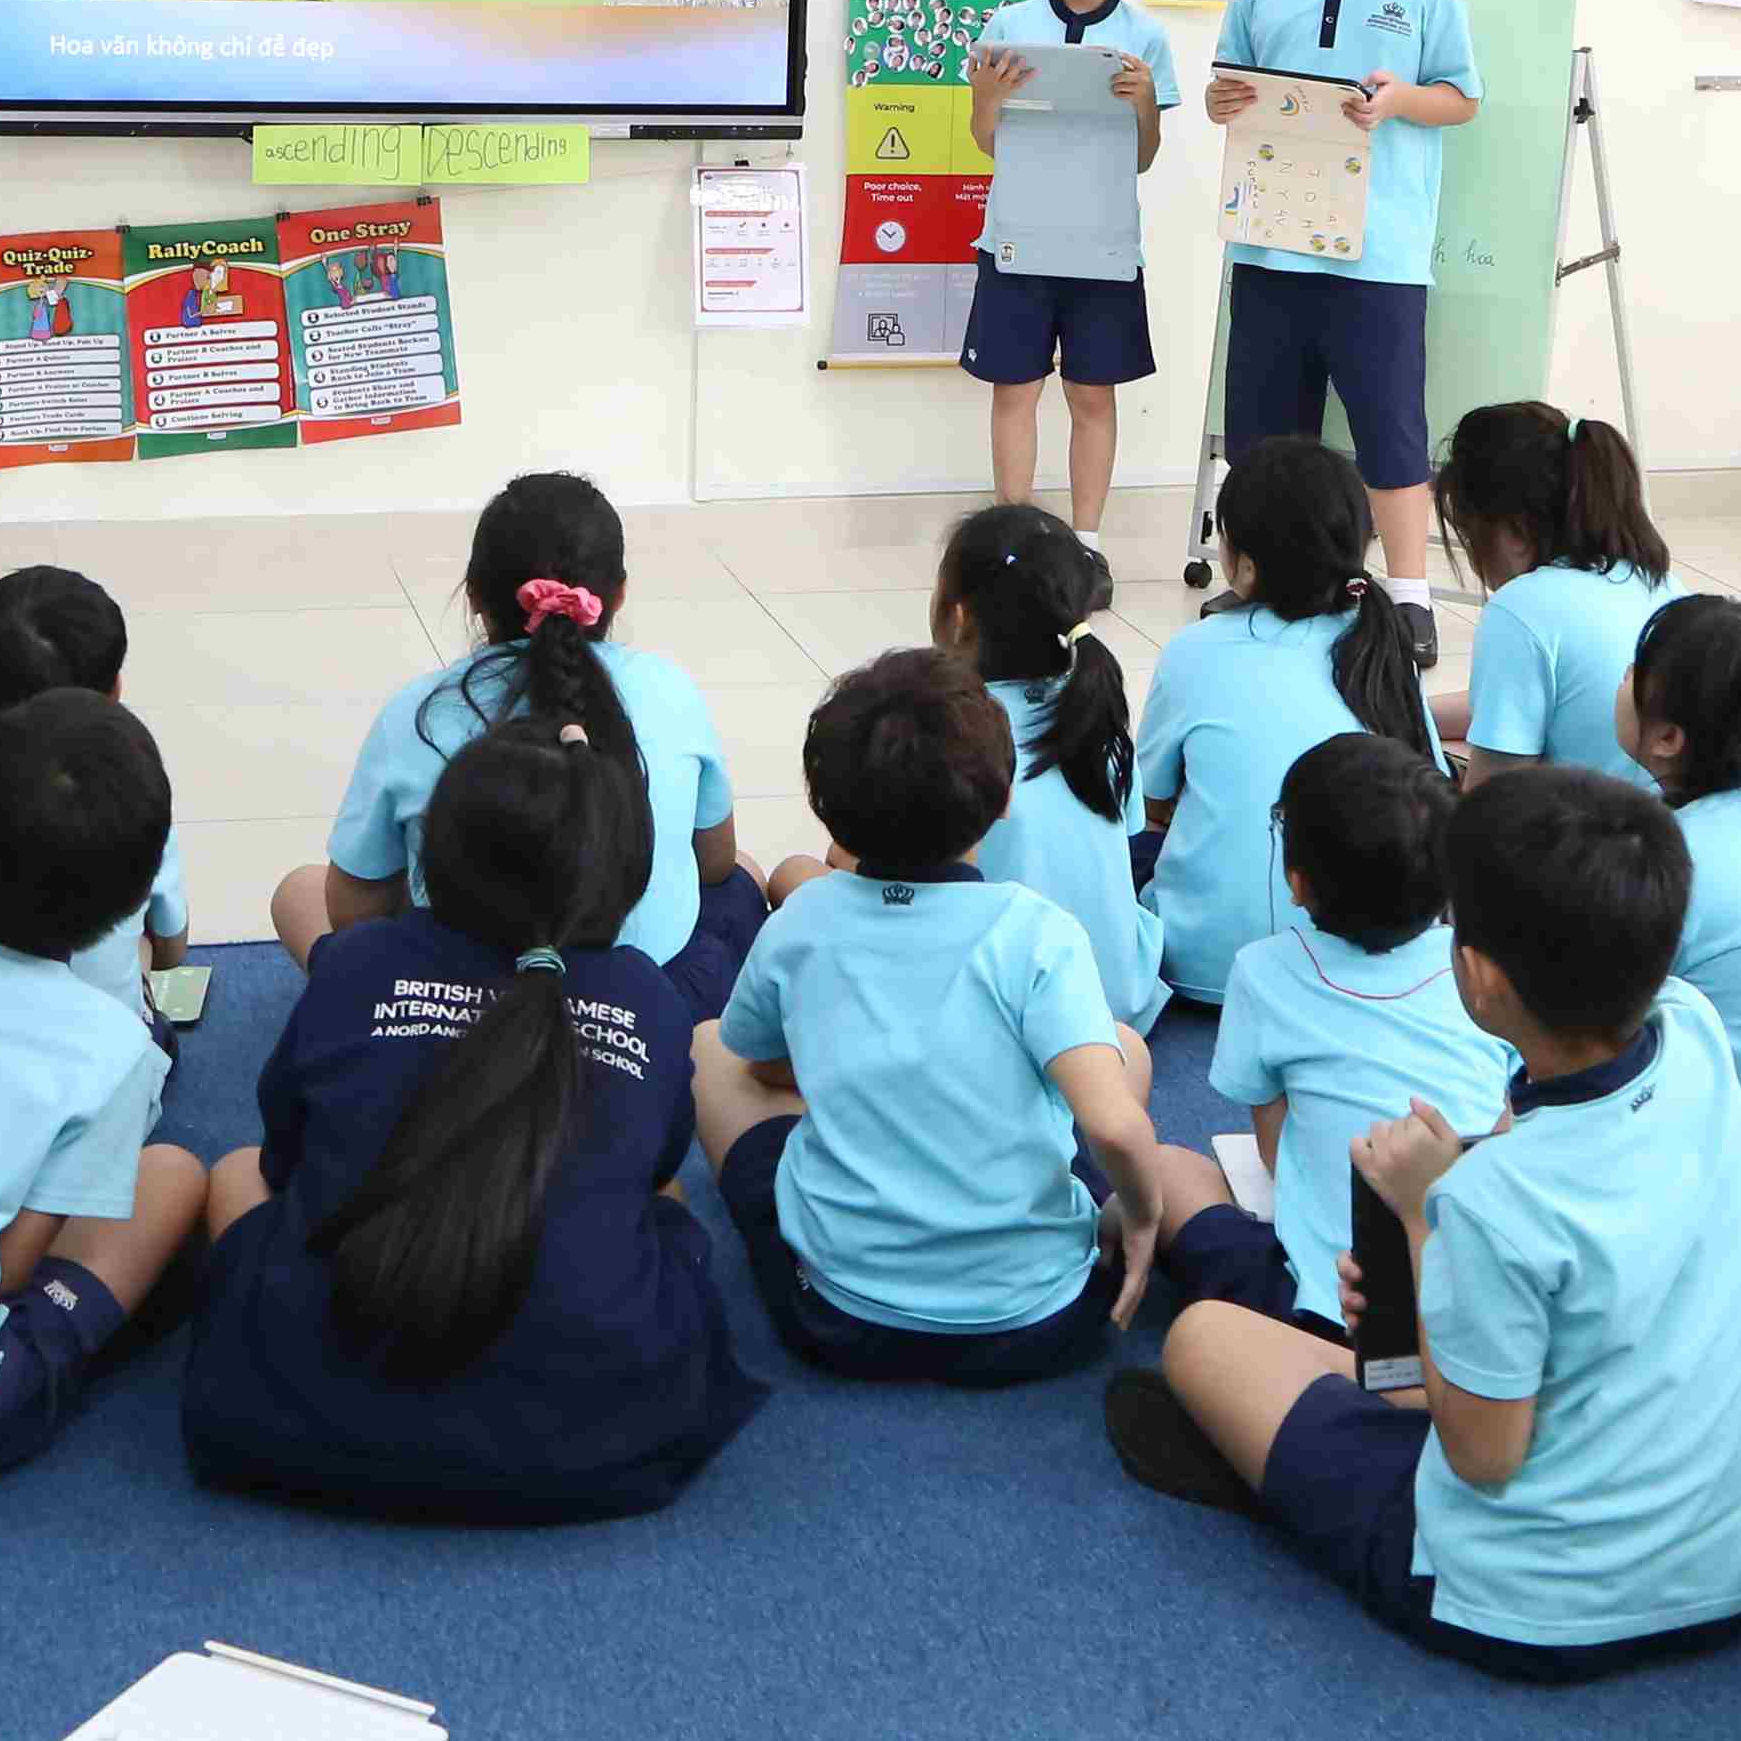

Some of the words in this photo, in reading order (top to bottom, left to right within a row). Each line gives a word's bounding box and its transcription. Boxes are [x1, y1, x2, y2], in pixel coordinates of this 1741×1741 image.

[50, 34, 93, 56] Hoa
[101, 36, 138, 55] văn
[147, 35, 214, 60] không
[292, 36, 334, 62] đẹp
[873, 102, 915, 114] Warning
[265, 125, 400, 180] ascending
[426, 127, 568, 177] Descending
[864, 181, 887, 192] Poor
[887, 181, 923, 193] choice,
[870, 192, 896, 203] Time
[896, 193, 914, 203] out
[310, 229, 350, 243] One
[355, 221, 410, 239] Stray
[3, 246, 93, 265] Quiz-Quiz-
[148, 238, 264, 259] RallyCoach
[22, 261, 74, 276] Trade
[394, 980, 482, 1004] BRITISH
[373, 1000, 482, 1024] INTERNAT
[385, 1023, 429, 1037] NORD
[592, 1048, 645, 1080] SCHOOL
